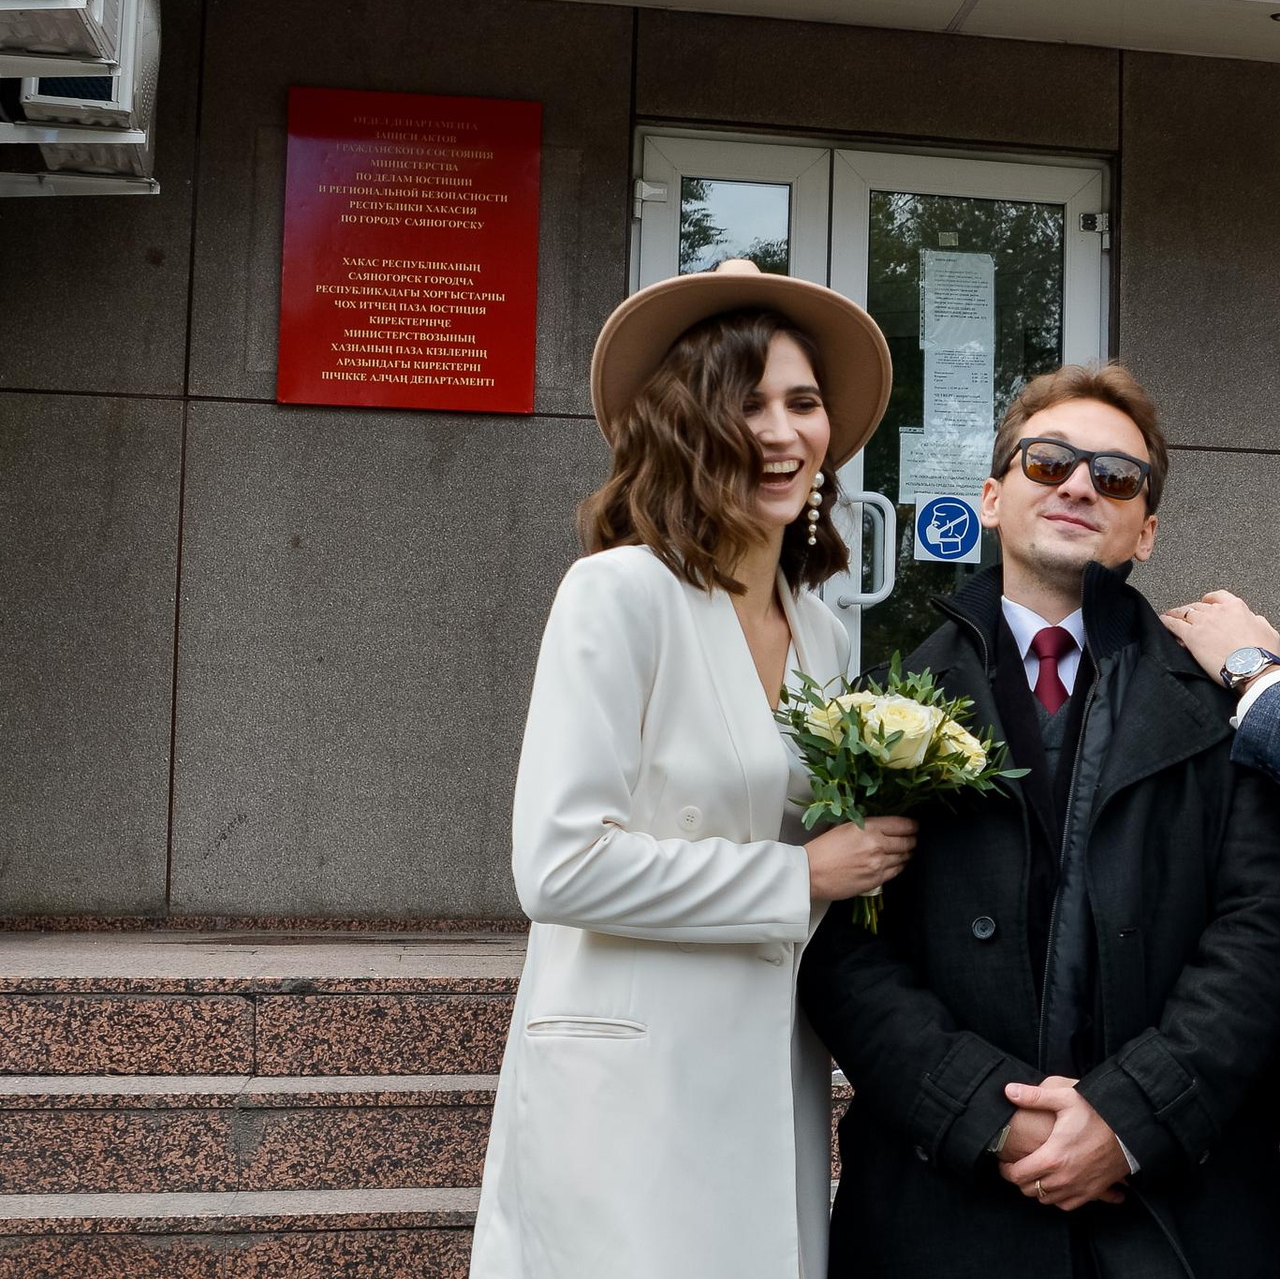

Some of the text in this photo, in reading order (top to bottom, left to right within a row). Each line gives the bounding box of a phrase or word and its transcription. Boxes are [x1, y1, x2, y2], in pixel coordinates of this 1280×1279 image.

[354, 116, 479, 131] ОТДЕЛ ДЕПАРТАМЕНТА
[375, 131, 457, 143] ЗАПИСИ АКТОВ
[336, 142, 494, 159] ГРАЖДАНСКОГО СОСТОЯНИЯ
[370, 159, 458, 171] МИНИСТЕРСТВА
[356, 172, 472, 187] ПО ДЕЛАМ ЮСТИЦИИ
[318, 184, 508, 202] И РЕГИОНАЛЬНОЙ БЕЗОПАСНОСТИ
[349, 200, 477, 215] РЕСПУБЛИКИ ХАКАСИЯ
[341, 215, 485, 230] ПО ГОРОДУ САЯНОГОРСКУ
[342, 257, 380, 267] ХАКАС
[348, 272, 474, 286] САЯНОГОРСК ГОРОДЧА
[334, 300, 356, 309] ЧОХ
[399, 303, 426, 312] ПАЗА
[430, 305, 486, 315] ЮСТИЦИЯ
[396, 346, 423, 355] ПАЗА
